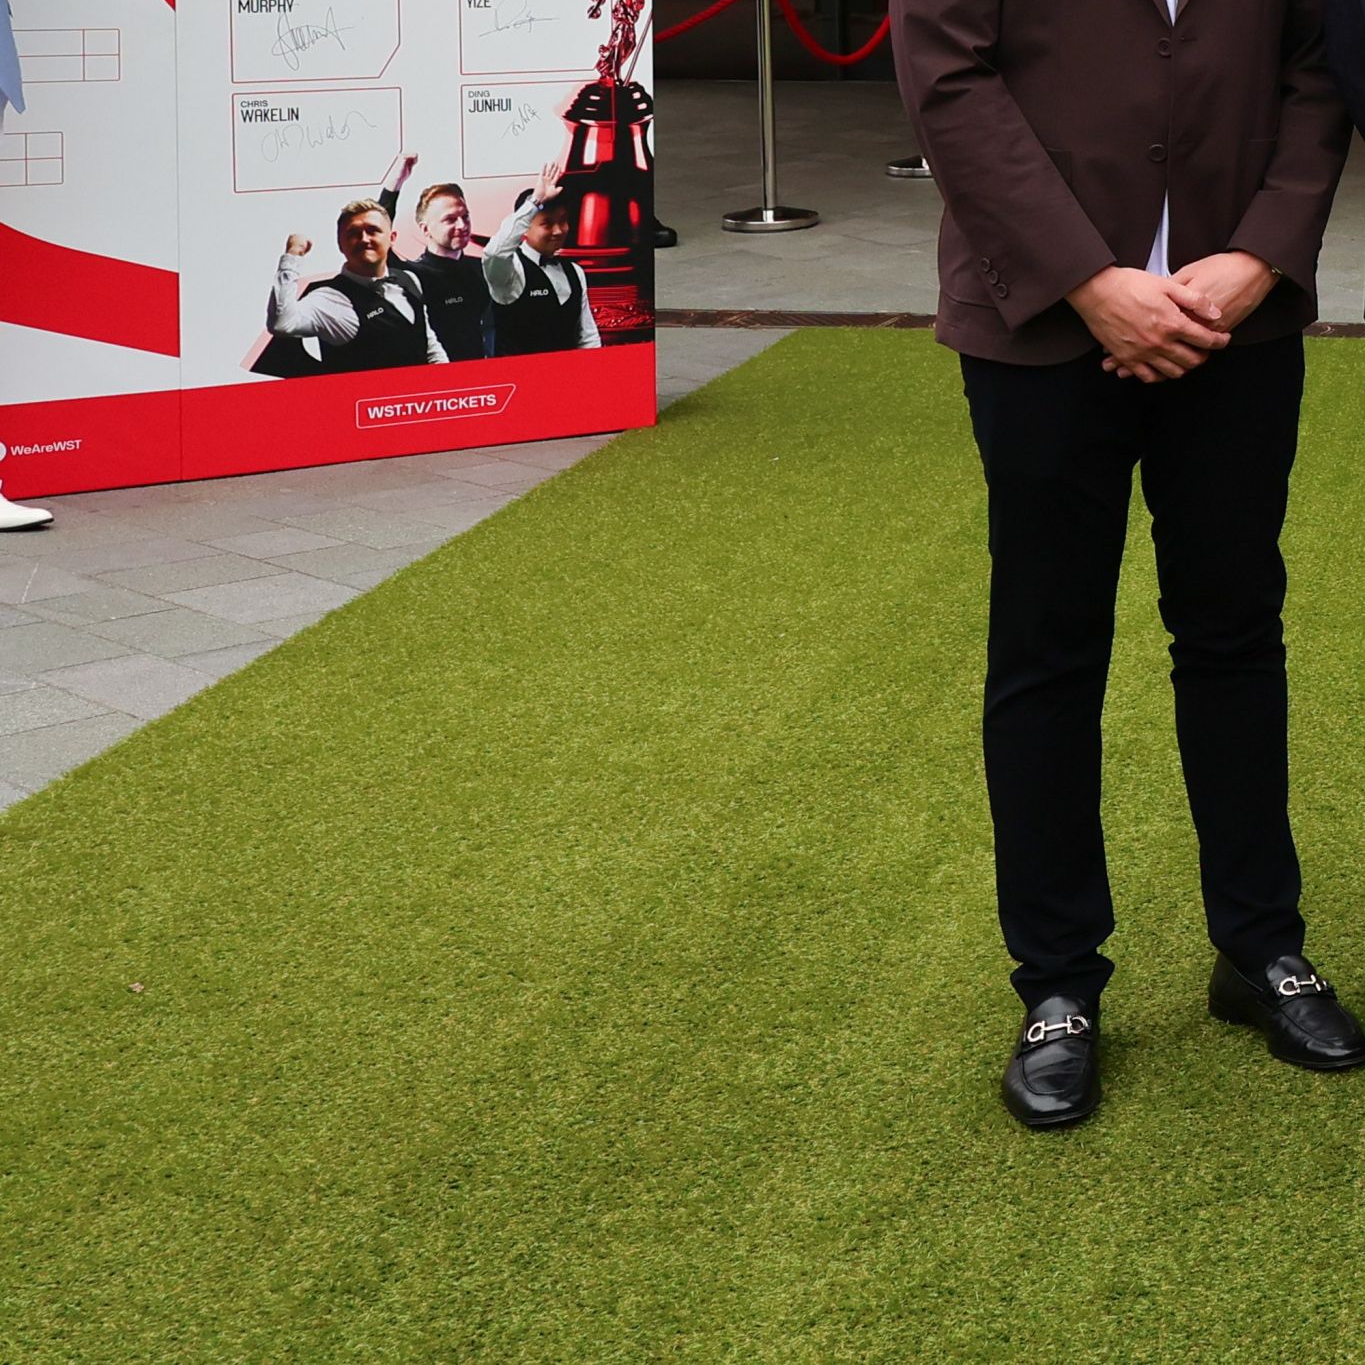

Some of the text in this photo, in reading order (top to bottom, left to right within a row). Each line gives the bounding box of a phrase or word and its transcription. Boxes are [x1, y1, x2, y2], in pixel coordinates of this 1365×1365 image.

[468, 90, 490, 98] DING
[240, 99, 268, 108] CHRIS
[468, 98, 512, 113] JUNHUI
[240, 107, 300, 123] WAKELIN
[530, 289, 549, 297] HALO
[445, 296, 463, 305] HALO
[367, 307, 384, 319] HALO
[367, 394, 497, 419] WST.TV/TICKETS
[10, 439, 82, 456] WeAreWST
